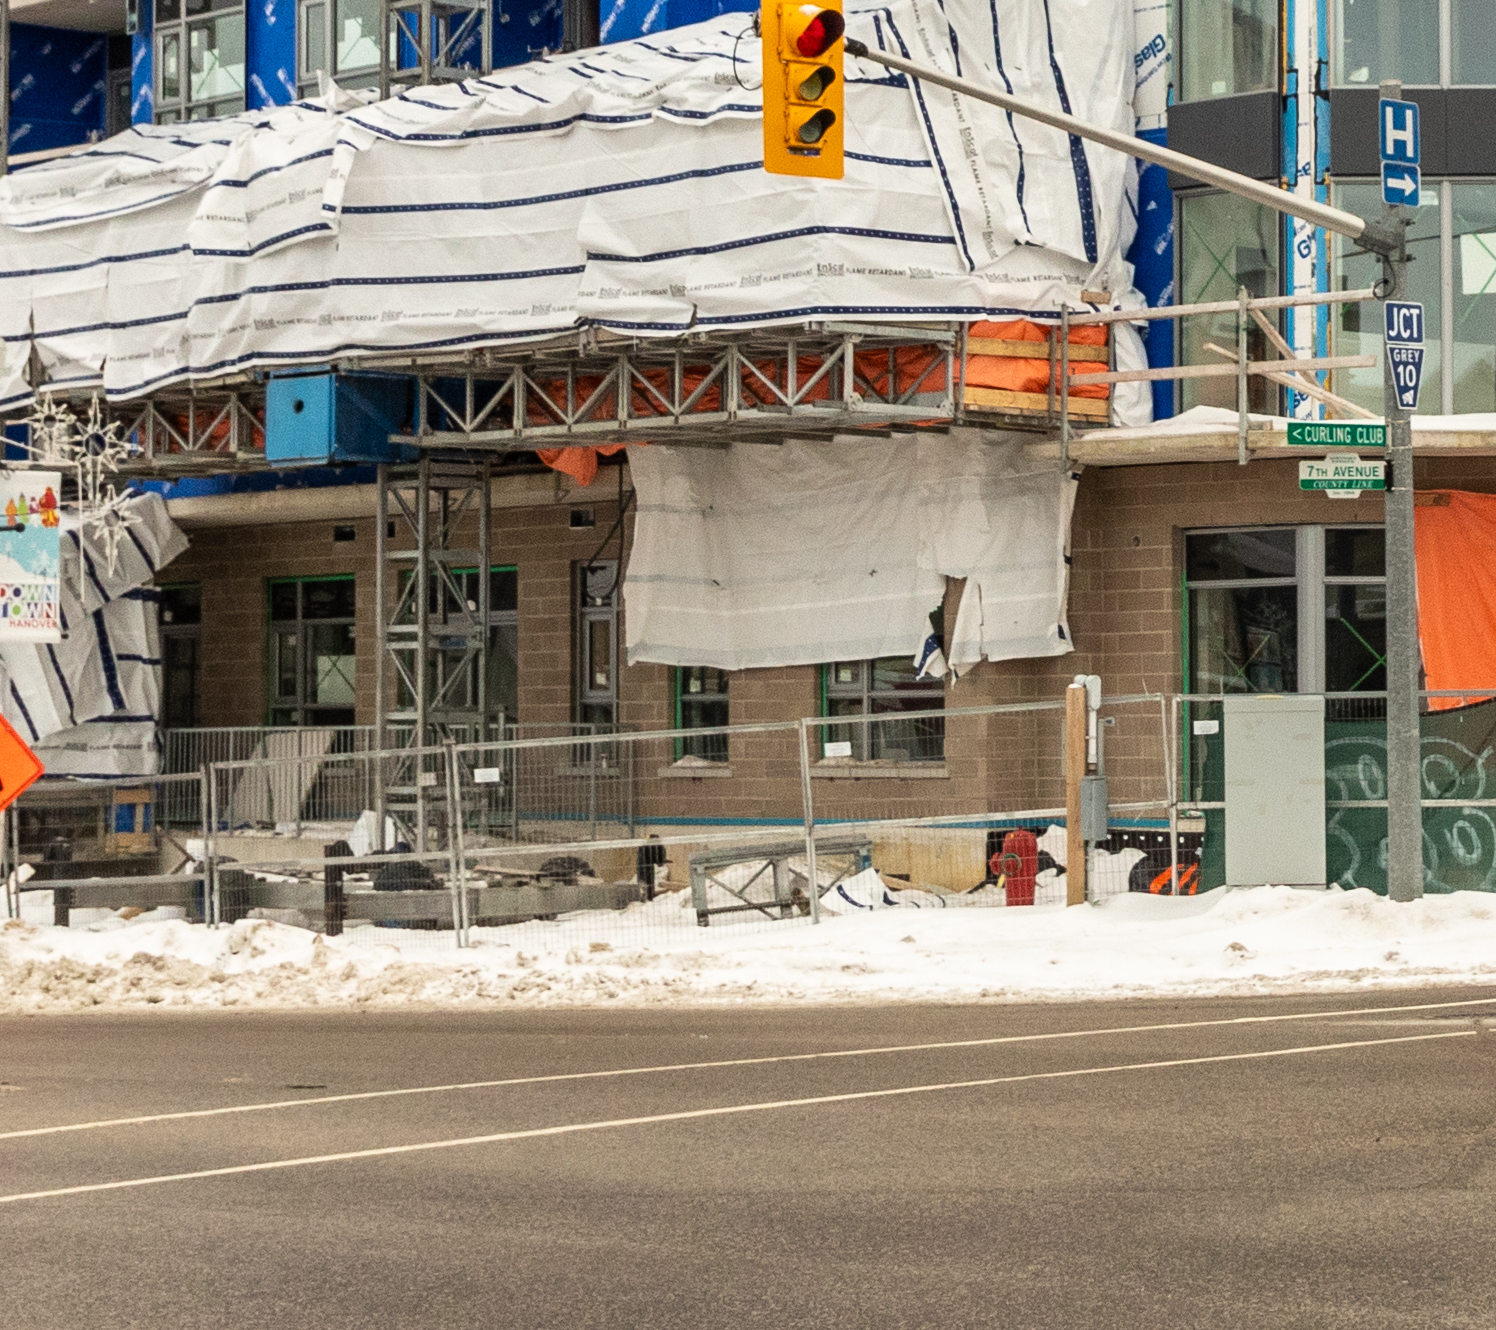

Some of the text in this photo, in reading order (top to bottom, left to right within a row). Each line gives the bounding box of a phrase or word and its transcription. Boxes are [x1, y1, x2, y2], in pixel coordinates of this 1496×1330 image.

[1385, 107, 1414, 158] H
[1388, 307, 1420, 339] JCT
[1393, 349, 1420, 362] GREY
[1396, 365, 1418, 387] 10
[1304, 426, 1384, 443] CURLING CLUB
[1333, 466, 1379, 477] AVENUE
[1313, 480, 1374, 489] COUNTY LINE
[9, 619, 57, 628] HANOVER
